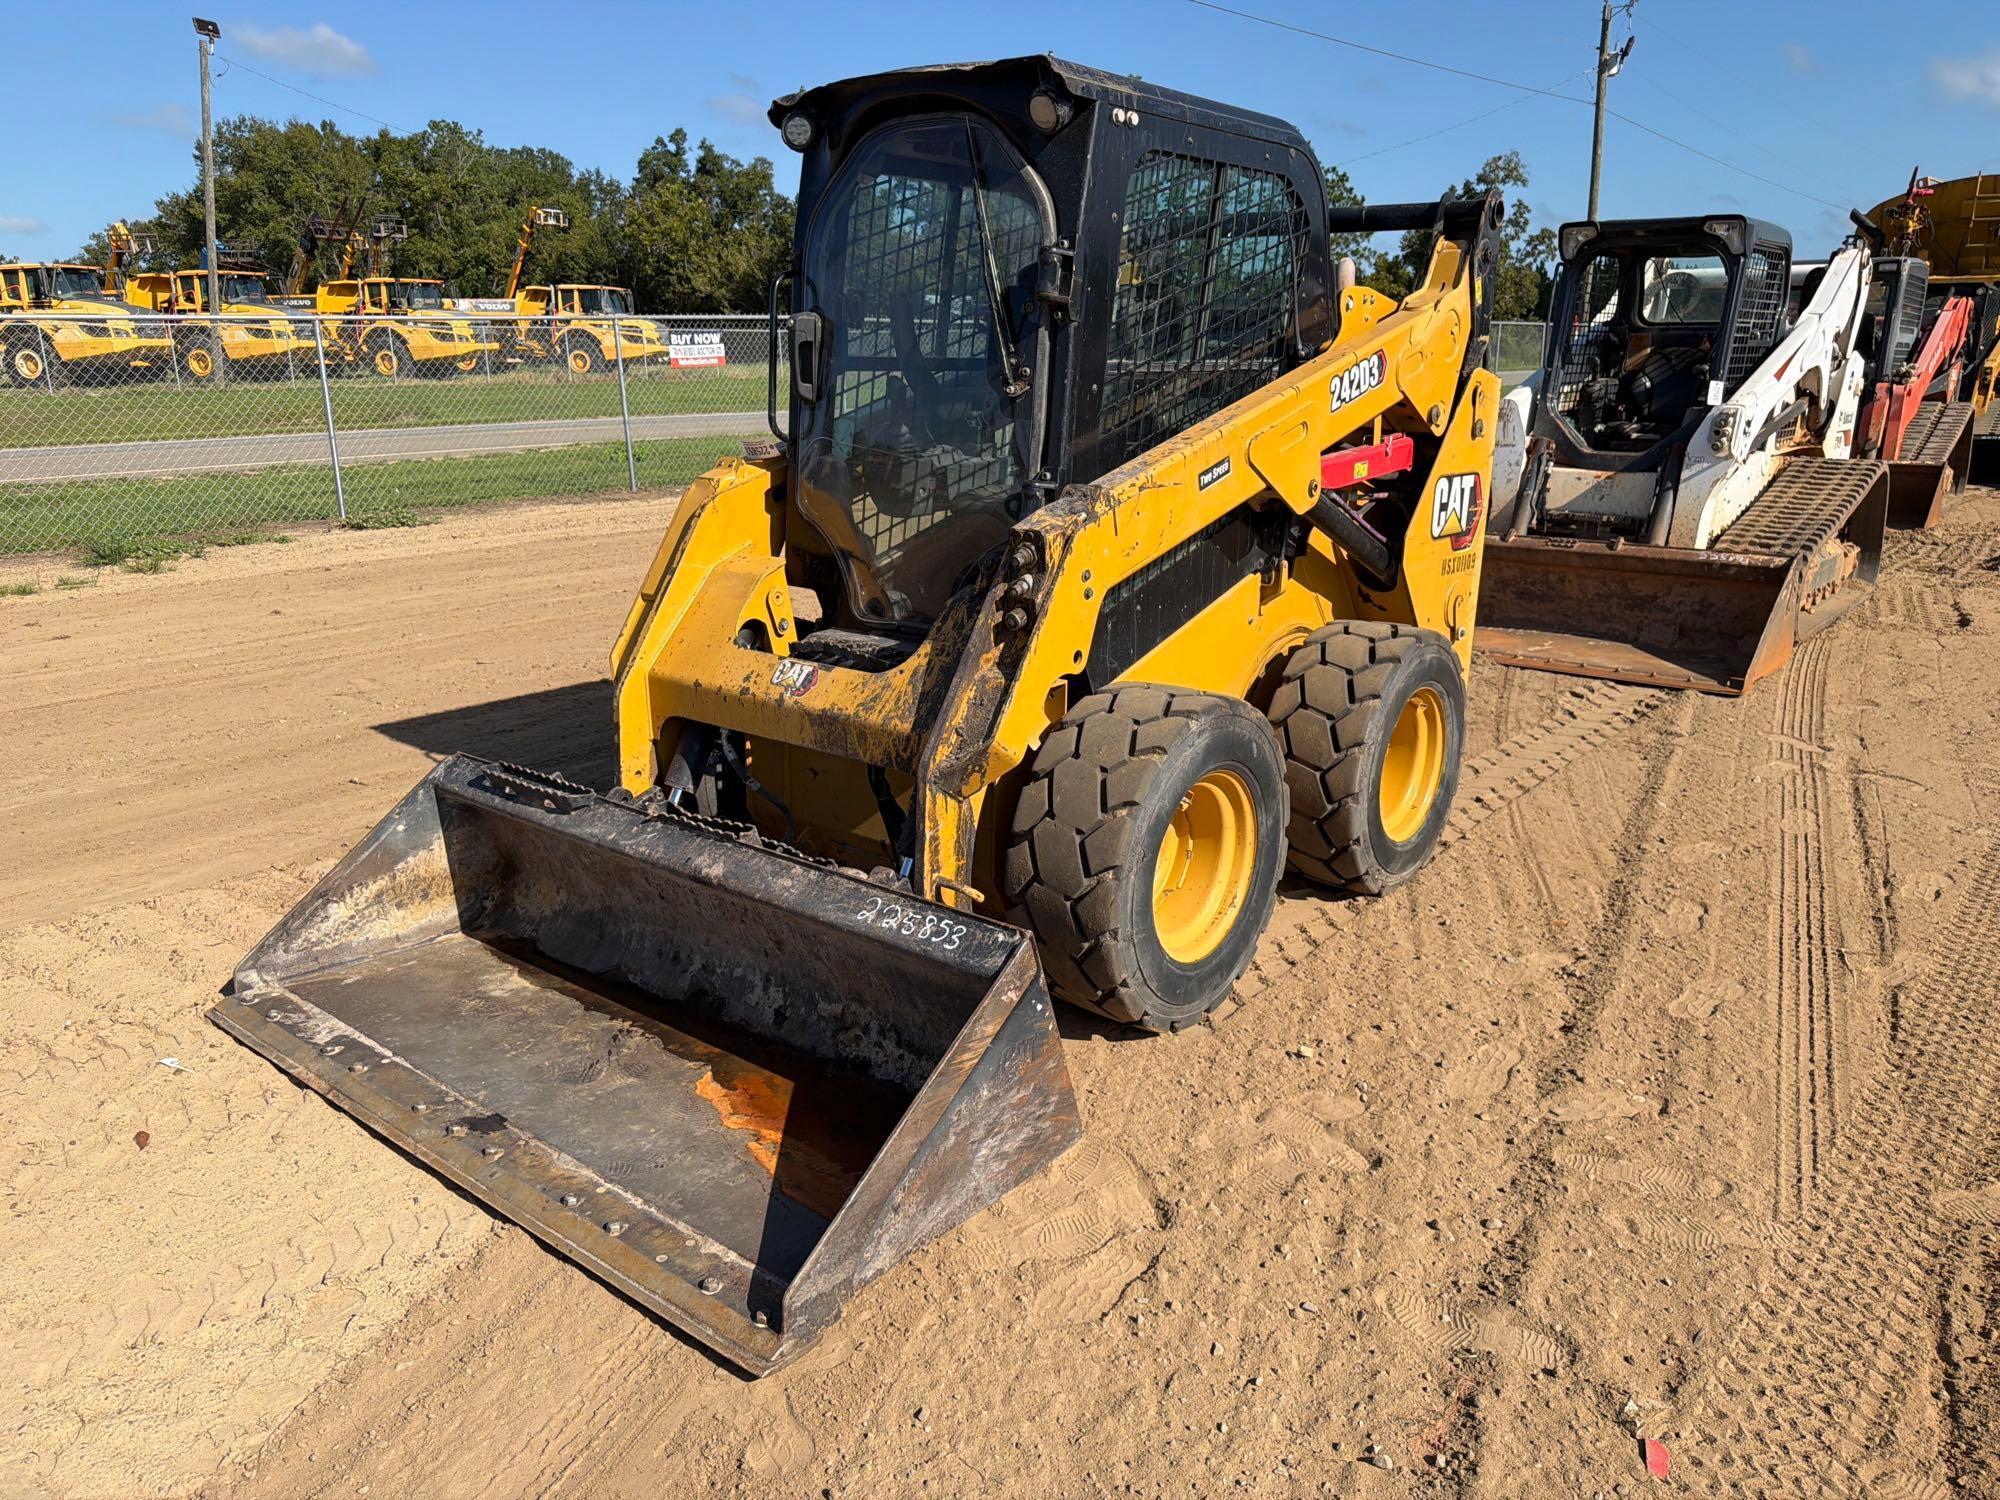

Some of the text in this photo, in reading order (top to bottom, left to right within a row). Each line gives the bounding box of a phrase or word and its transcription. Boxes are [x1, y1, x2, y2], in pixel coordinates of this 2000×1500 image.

[479, 302, 511, 310] VOLVO
[670, 333, 720, 345] BUY NOW
[1330, 353, 1379, 412] 242D3
[1431, 474, 1475, 538] CAT
[771, 660, 814, 689] CAT
[857, 897, 967, 949] 225853
